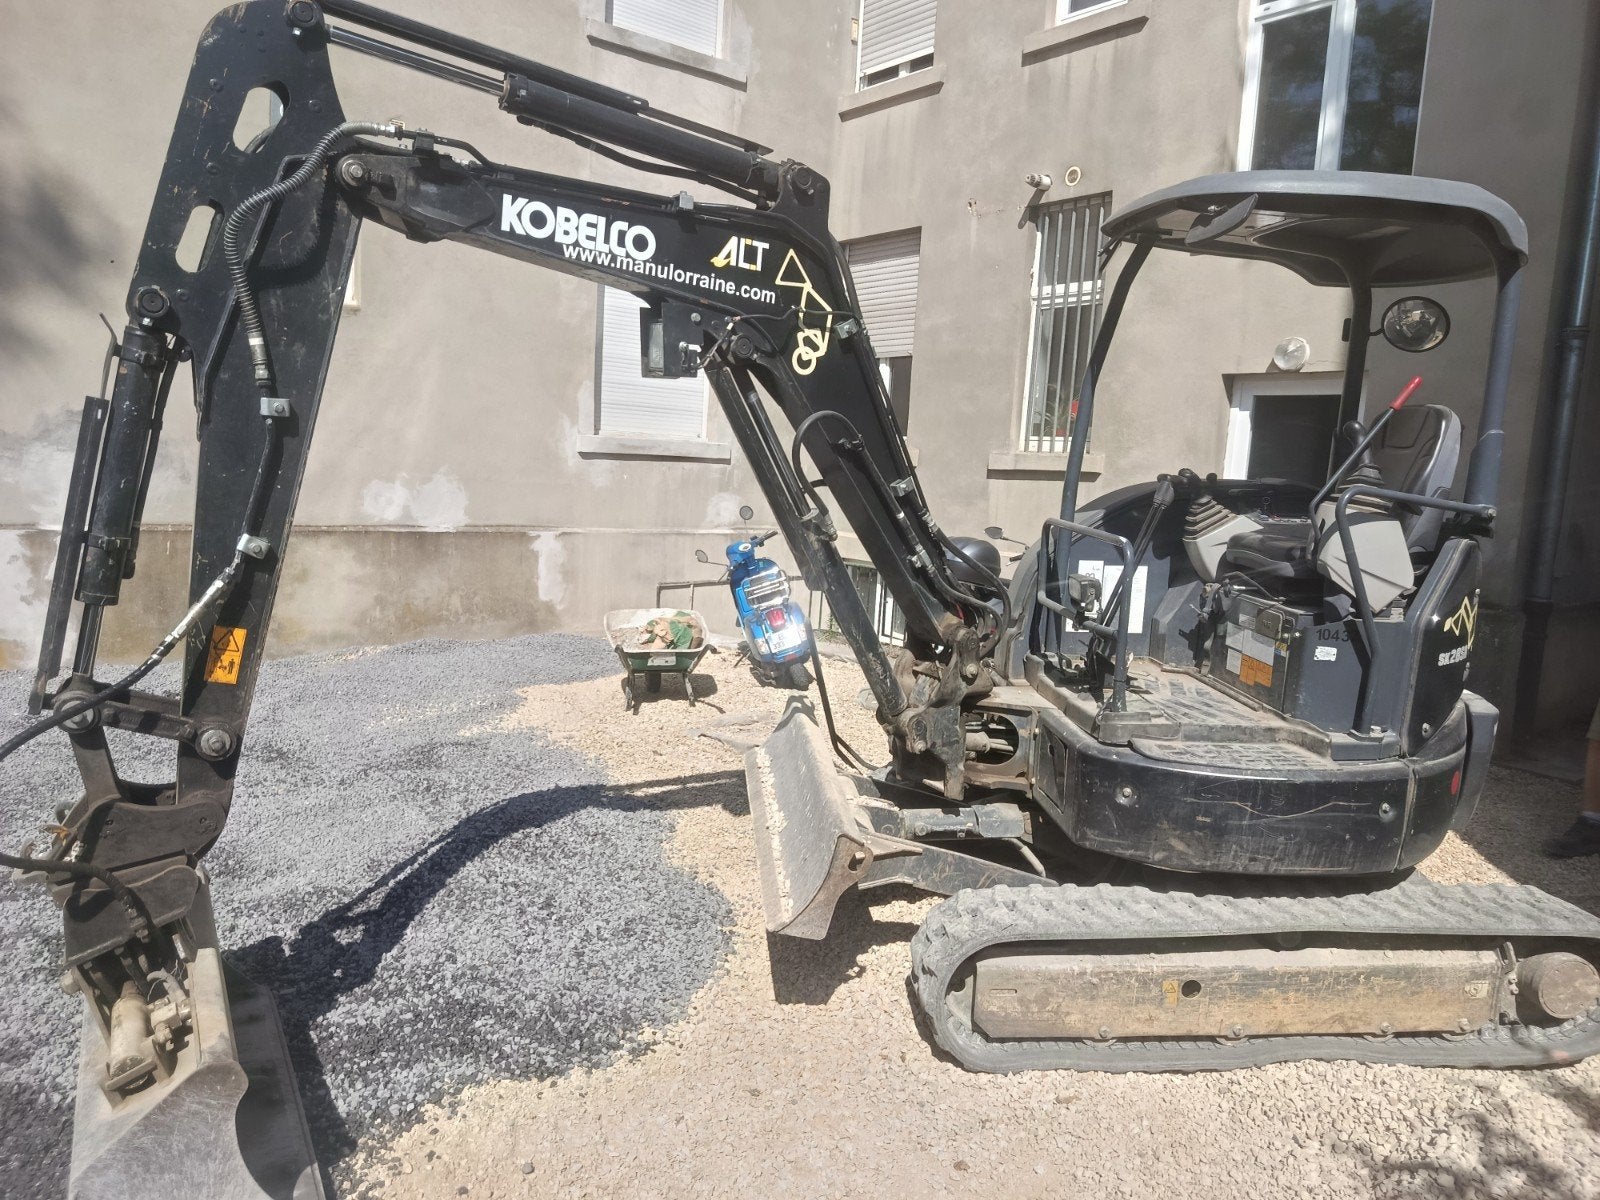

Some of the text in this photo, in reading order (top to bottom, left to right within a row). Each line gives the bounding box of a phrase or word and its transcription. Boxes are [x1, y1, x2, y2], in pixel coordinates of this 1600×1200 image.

[500, 193, 657, 261] KOBELCO
[710, 235, 770, 272] ALT
[562, 243, 776, 305] www.manulorraine.com
